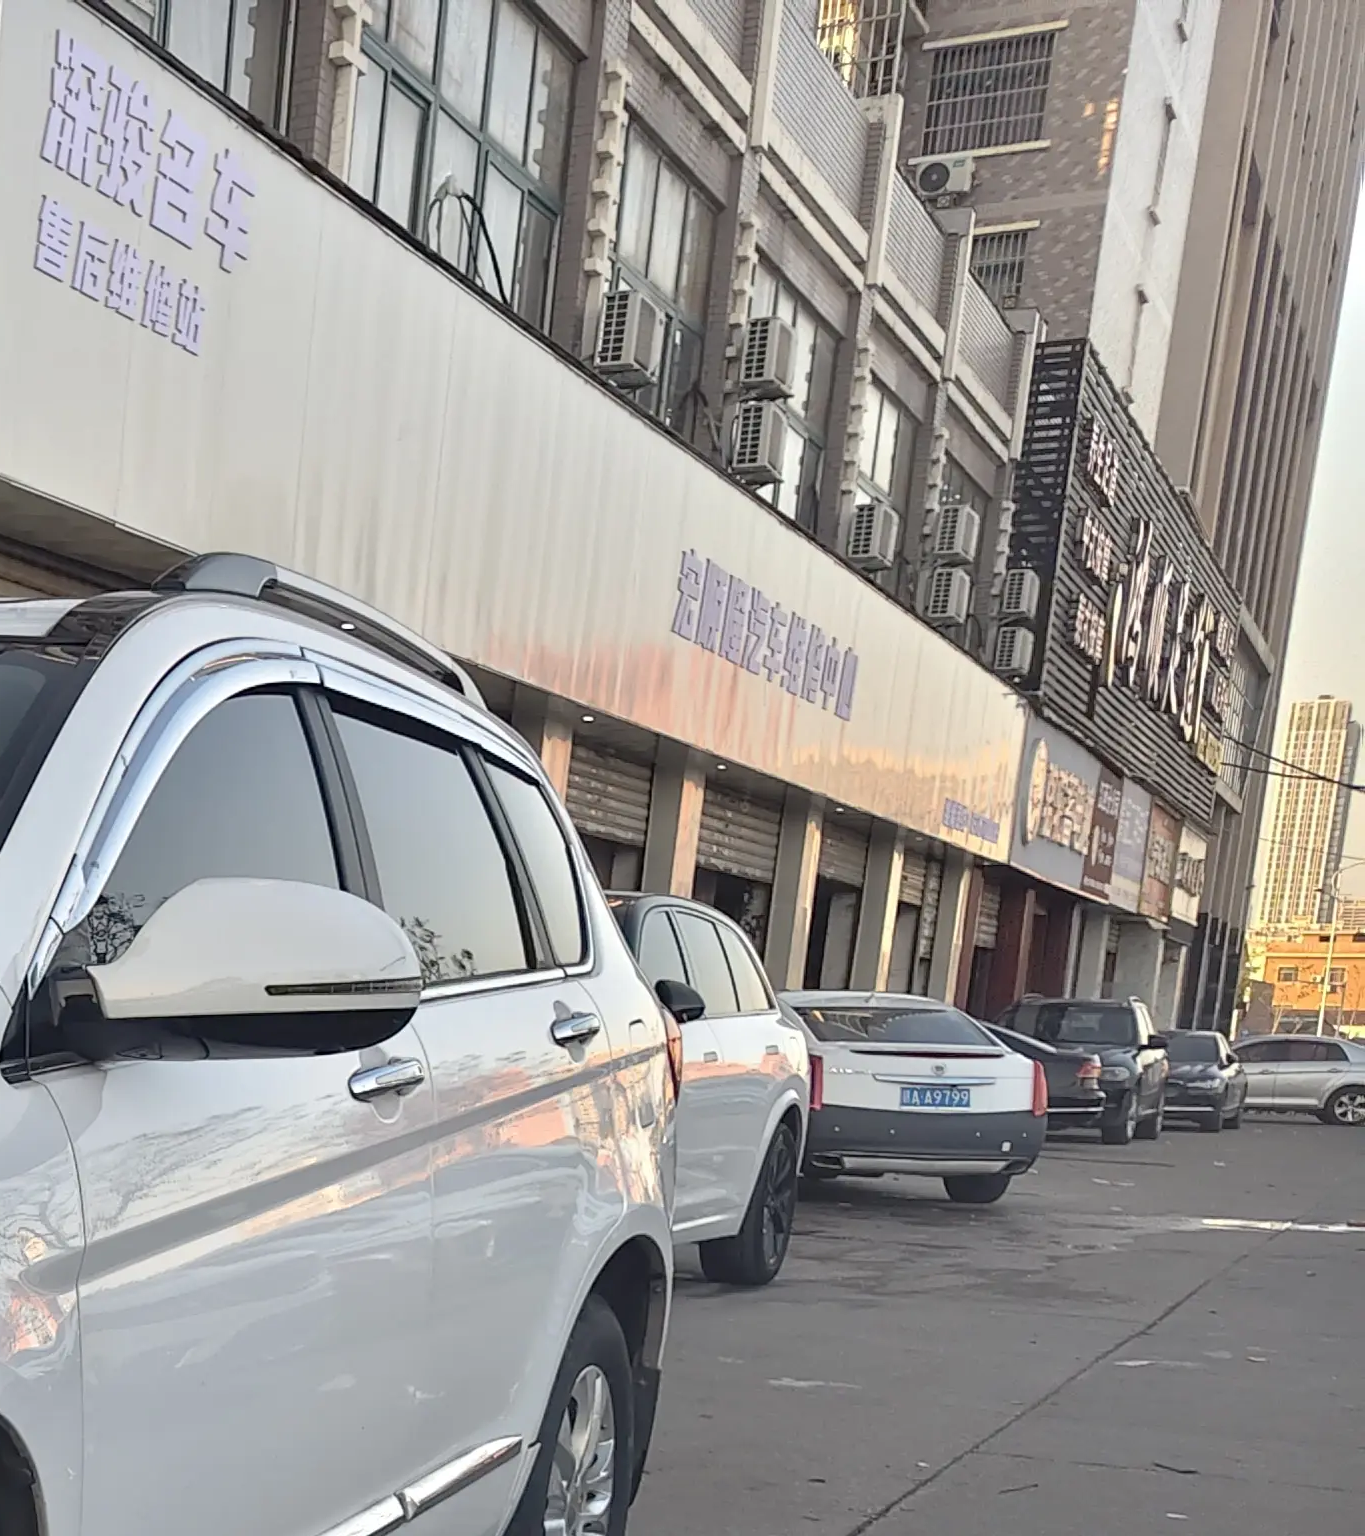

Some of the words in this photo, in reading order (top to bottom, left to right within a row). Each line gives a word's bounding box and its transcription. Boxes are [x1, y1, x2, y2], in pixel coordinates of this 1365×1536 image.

[39, 28, 257, 274] 深骏名车
[33, 194, 206, 357] 售后维修站
